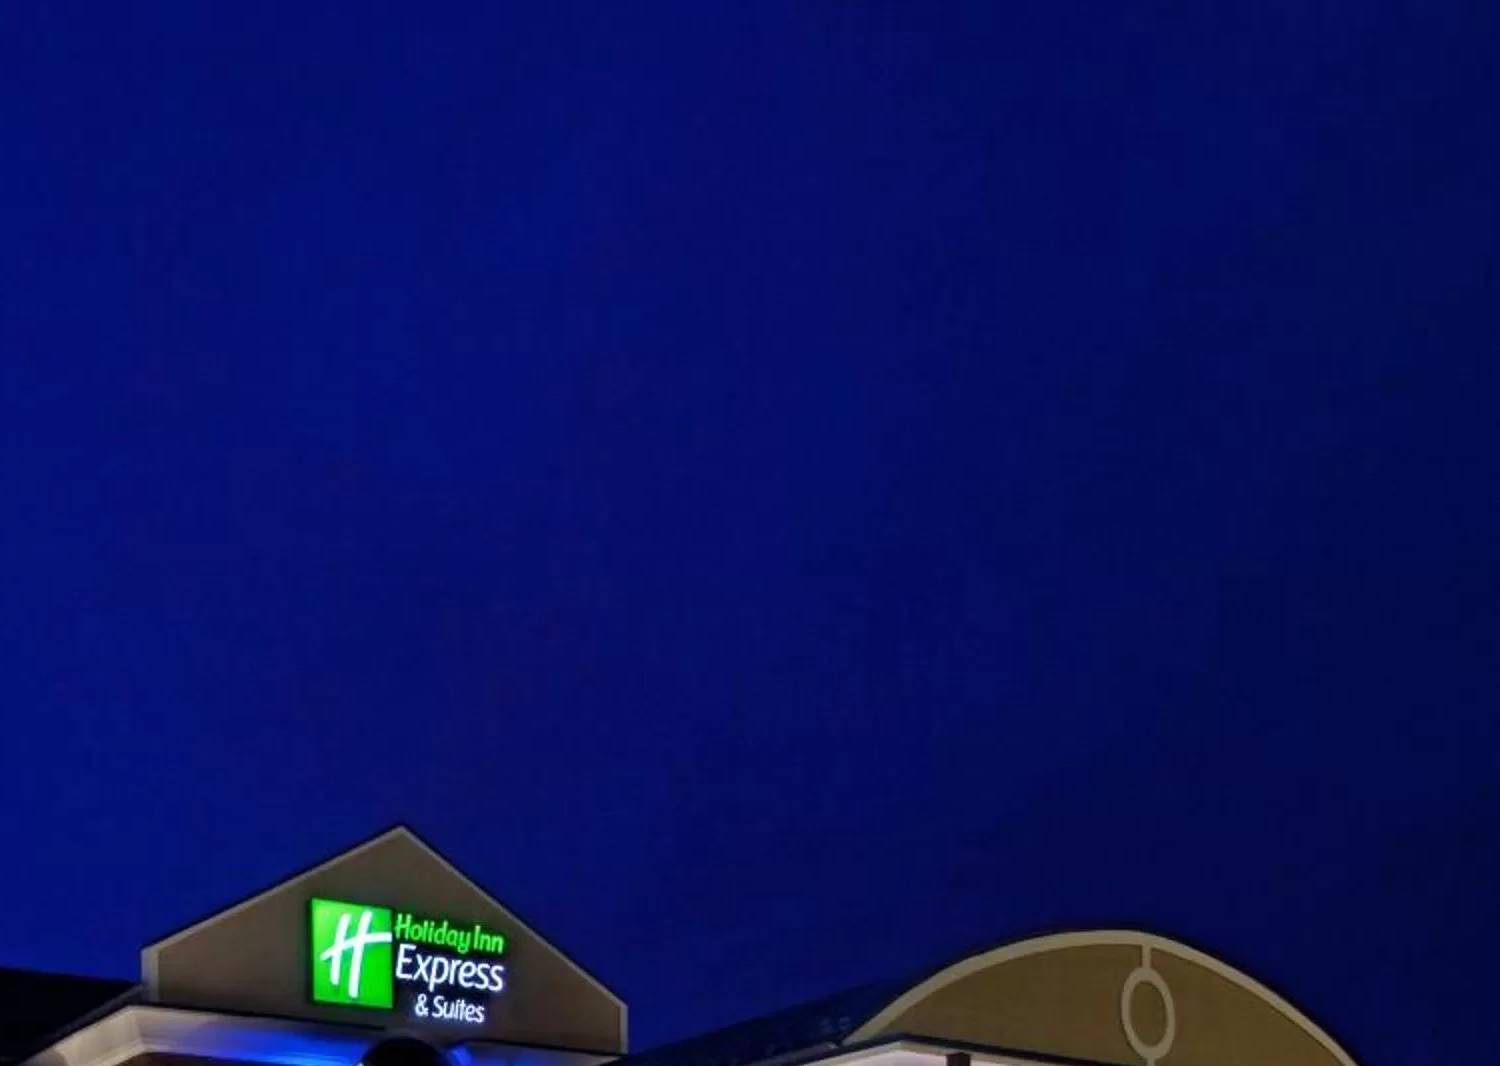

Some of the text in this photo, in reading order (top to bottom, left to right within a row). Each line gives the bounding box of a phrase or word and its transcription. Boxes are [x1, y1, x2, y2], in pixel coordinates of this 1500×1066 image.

[395, 913, 504, 954] Holiday Inn
[396, 944, 504, 992] Express
[415, 994, 485, 1023] & Suites
